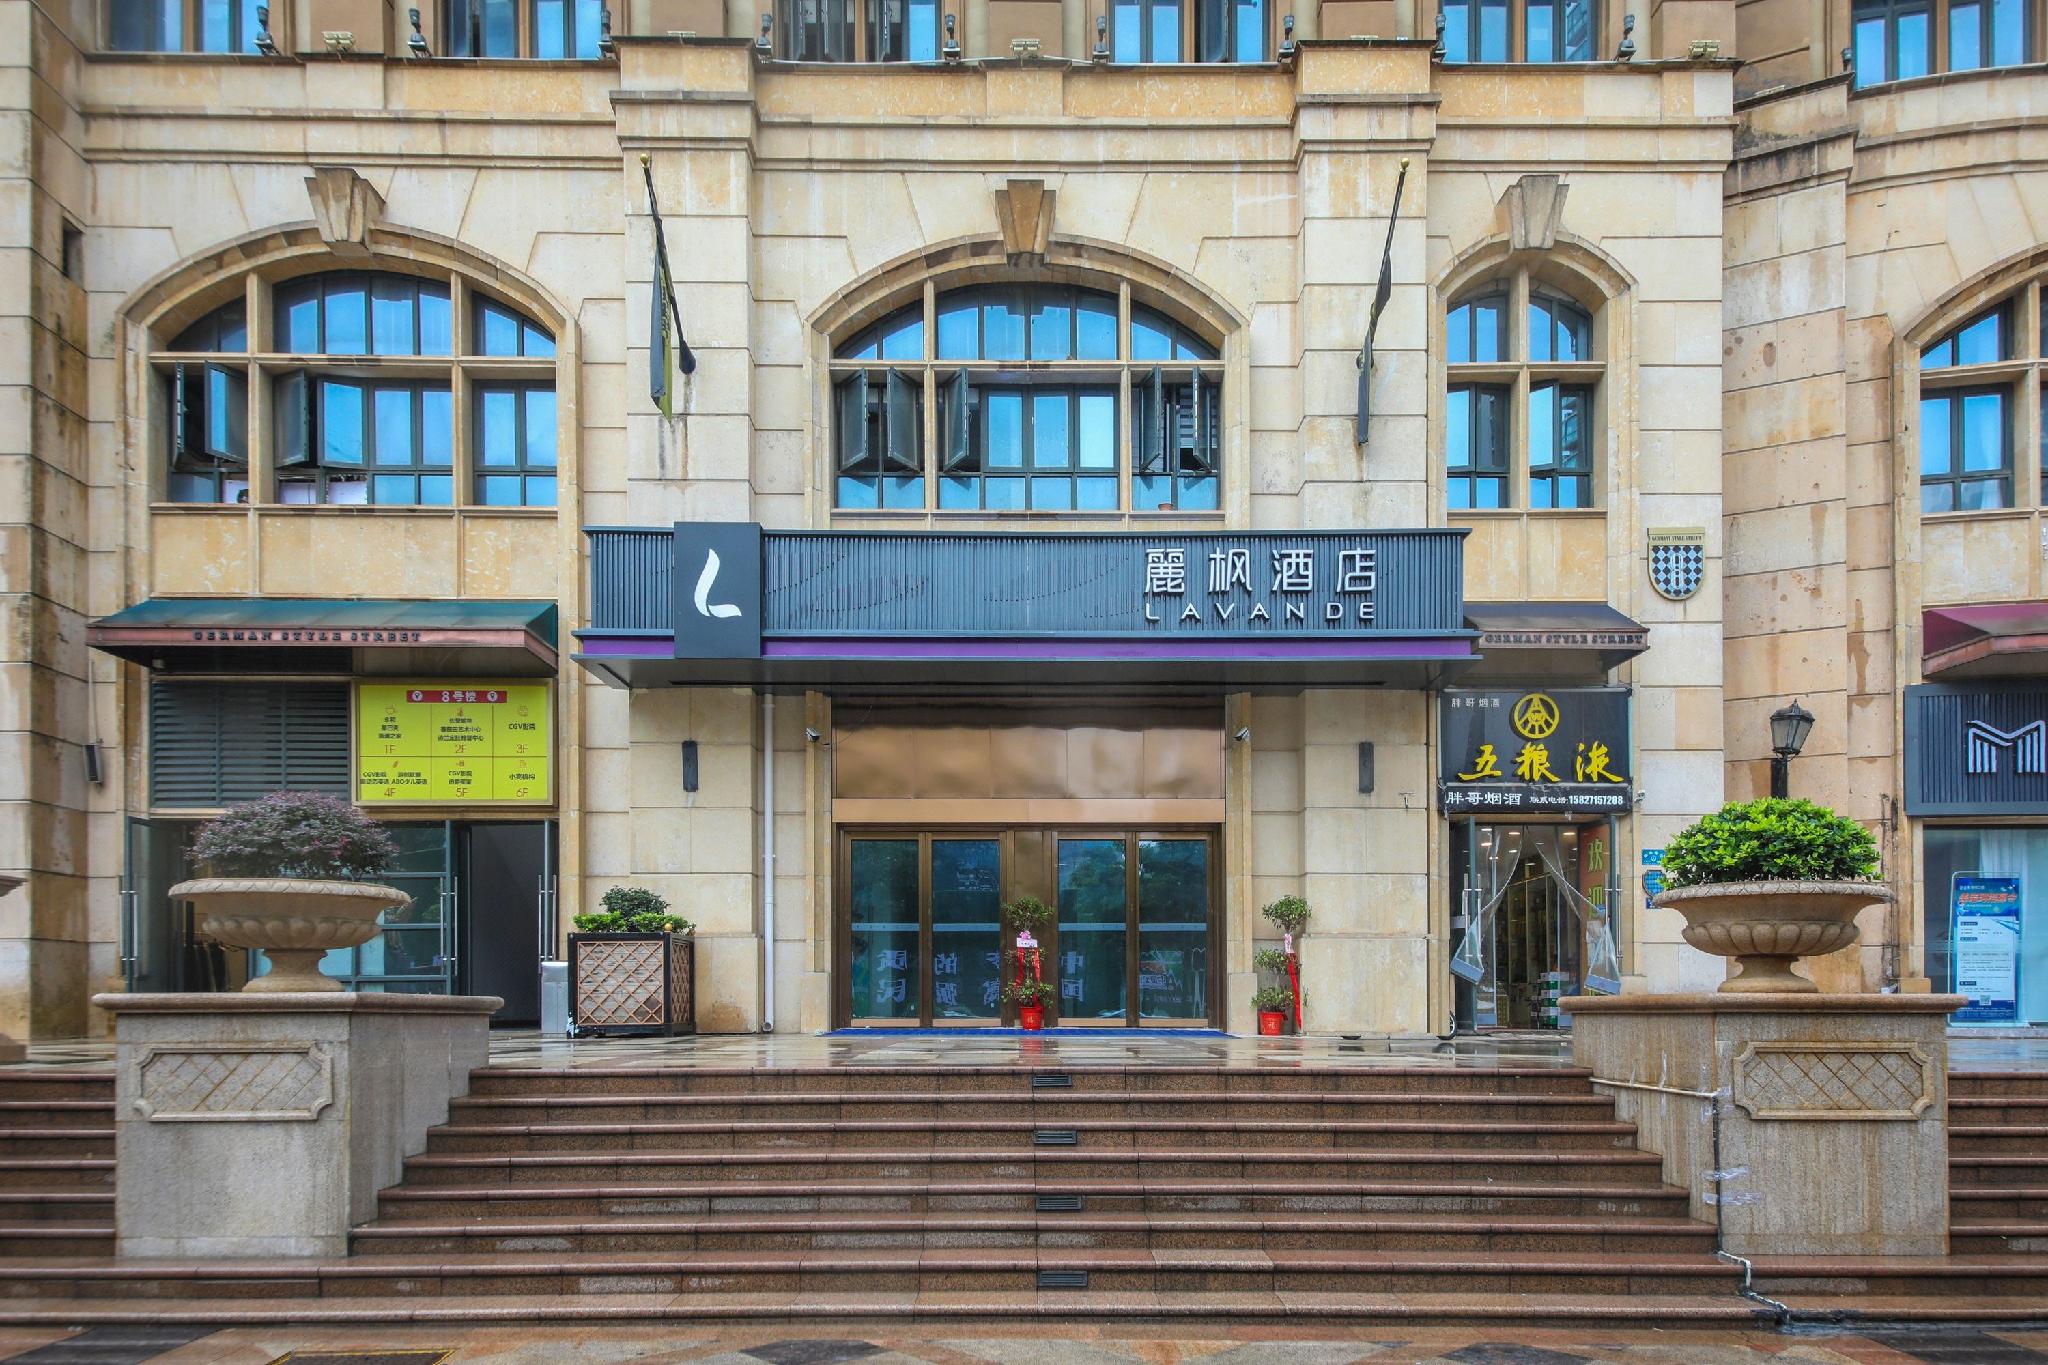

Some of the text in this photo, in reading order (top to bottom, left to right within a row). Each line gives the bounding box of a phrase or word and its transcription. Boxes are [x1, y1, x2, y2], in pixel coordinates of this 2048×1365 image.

[1144, 547, 1376, 593] 麗枫酒店
[1145, 602, 1375, 620] LAVANDE
[193, 631, 421, 642] GERMAN STYLE STREET
[1485, 634, 1643, 645] GERMAN STYLE STREET
[441, 690, 477, 703] 8号楼
[1451, 697, 1501, 708] 胖哥烟酒
[455, 744, 467, 754] 2F
[516, 744, 528, 754] 3F
[1457, 741, 1625, 783] 五粮液
[384, 787, 396, 797] 4F
[455, 787, 468, 798] 5F
[516, 787, 528, 798] 6F
[1446, 791, 1522, 805] 胖哥烟酒
